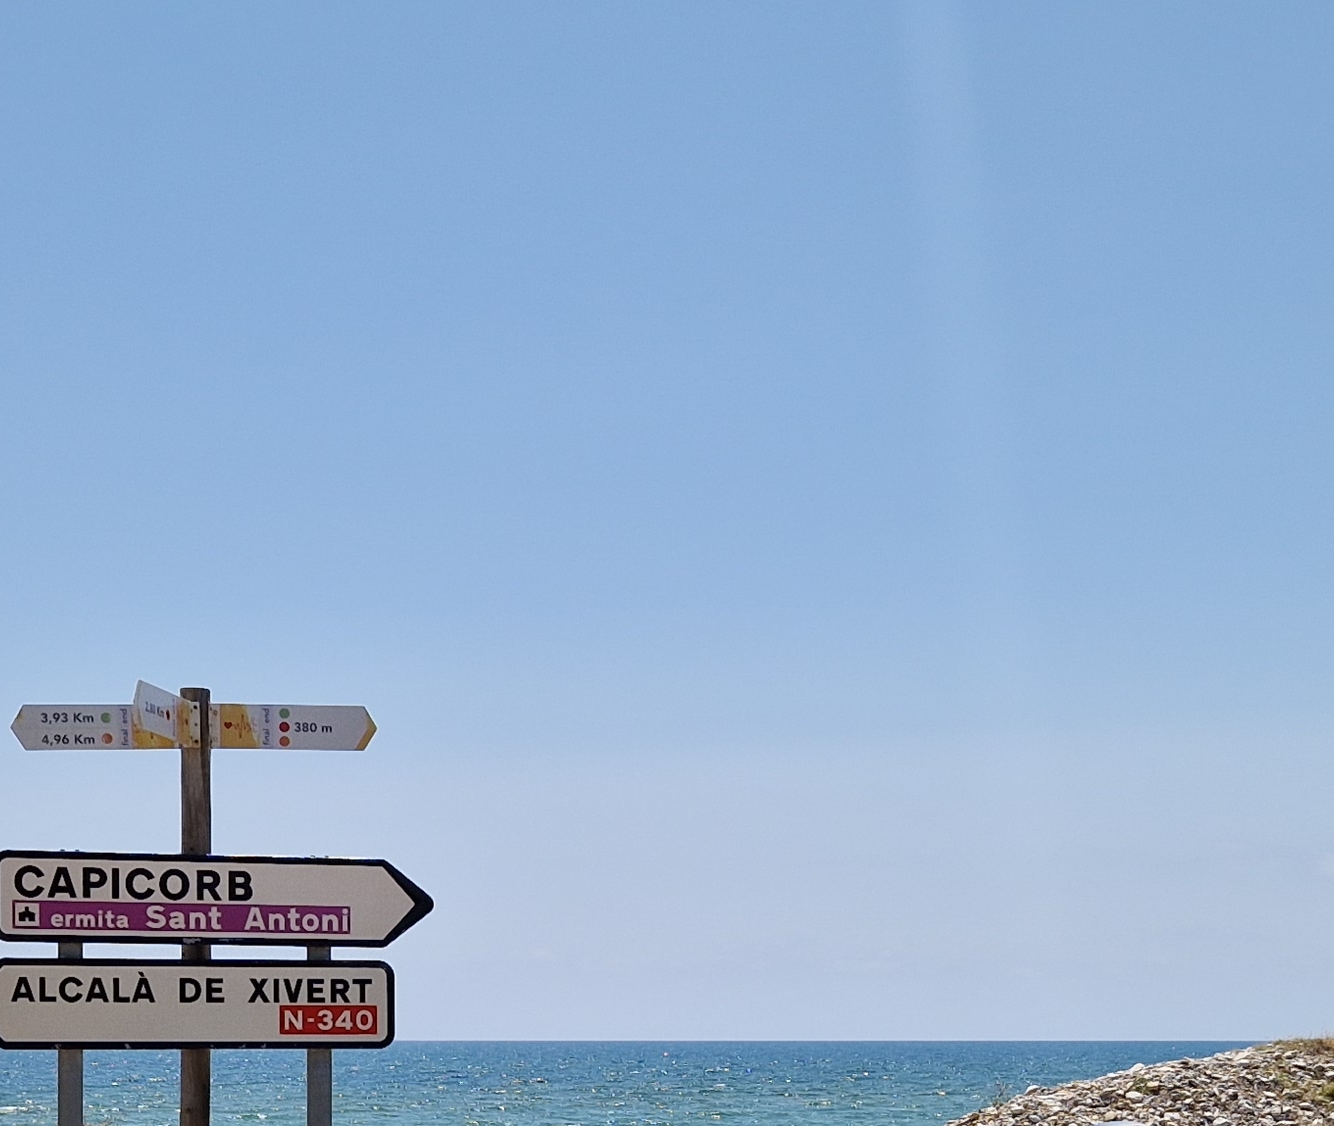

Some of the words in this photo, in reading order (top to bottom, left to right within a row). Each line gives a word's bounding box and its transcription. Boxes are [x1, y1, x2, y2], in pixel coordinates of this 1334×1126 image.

[40, 712, 69, 724] 3,93
[73, 712, 94, 723] Km
[294, 722, 318, 733] 380
[321, 725, 333, 733] m
[41, 734, 70, 746] 4,96
[74, 734, 95, 745] Km
[14, 865, 254, 901] CAPICORB
[50, 909, 129, 929] ermita
[145, 906, 222, 931] Sant
[244, 906, 349, 933] Antoni
[11, 971, 156, 1003] ALCALÀ
[178, 977, 225, 1003] DE
[248, 978, 373, 1004] XIVERT
[283, 1009, 374, 1031] N-340
